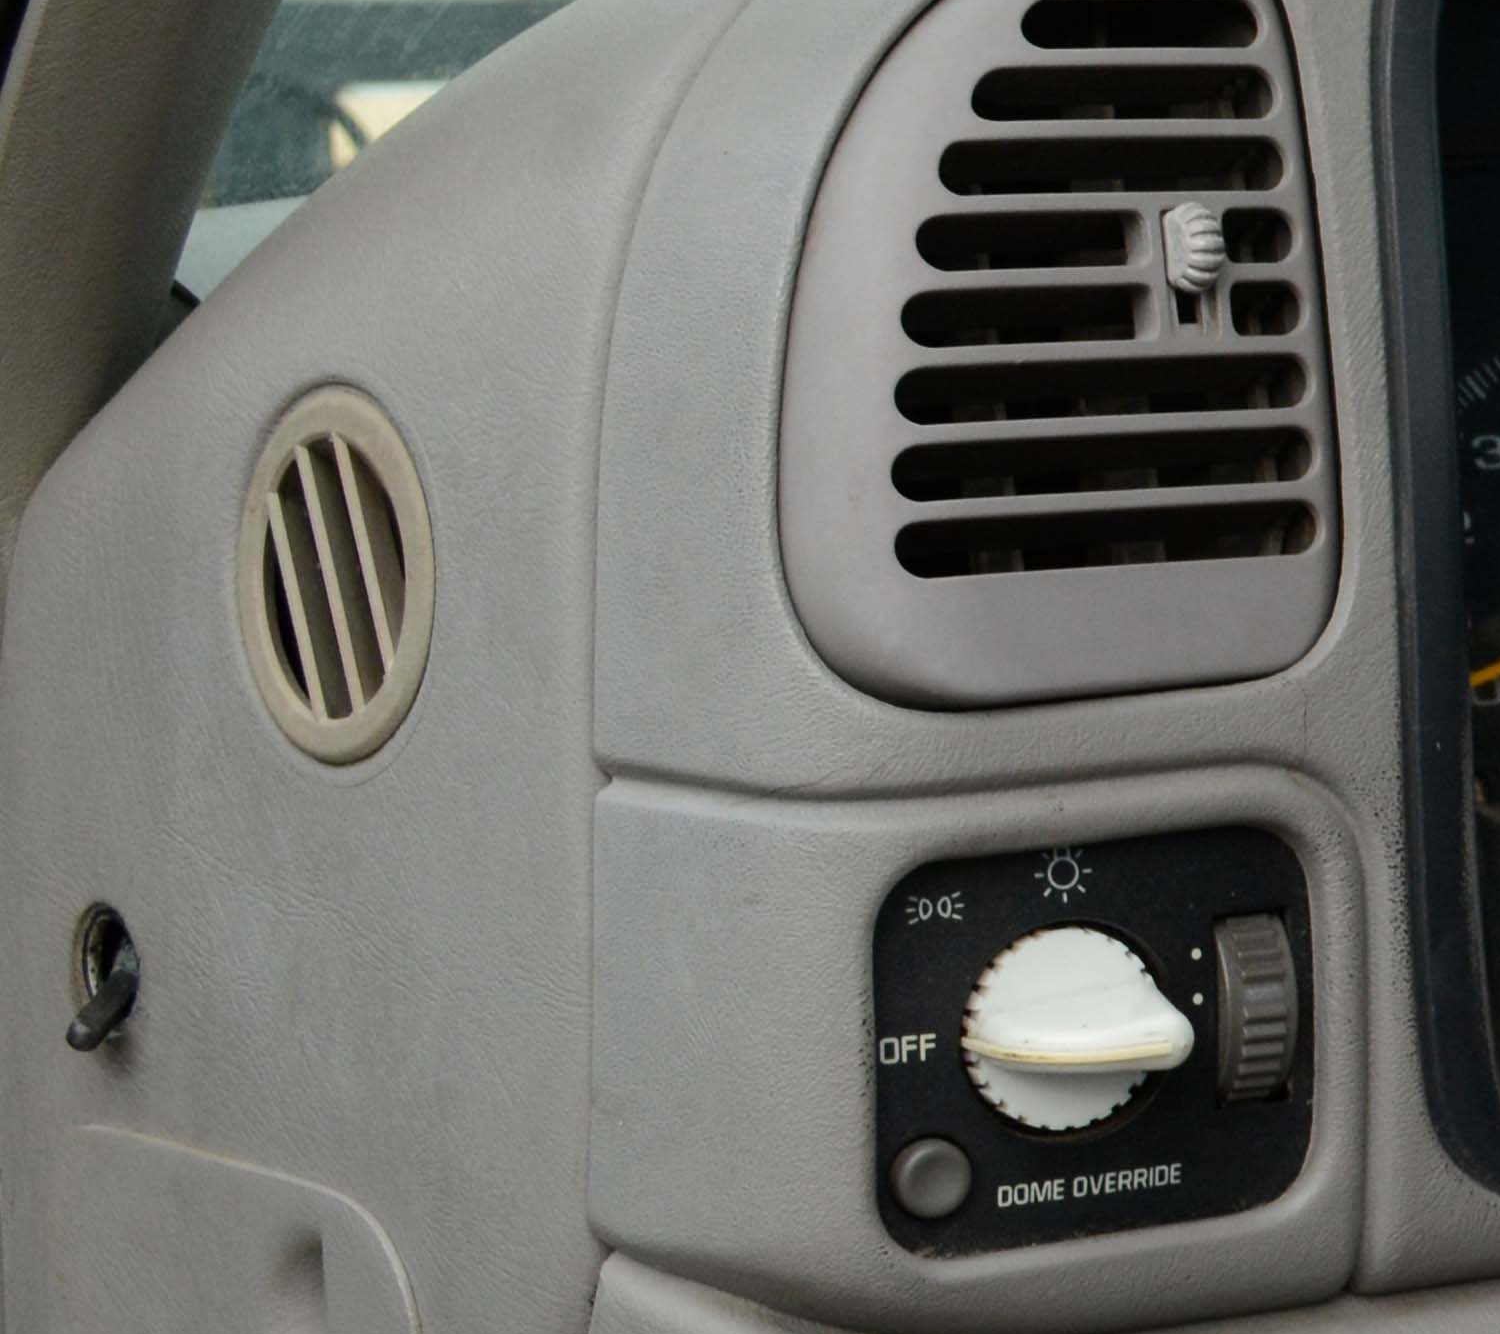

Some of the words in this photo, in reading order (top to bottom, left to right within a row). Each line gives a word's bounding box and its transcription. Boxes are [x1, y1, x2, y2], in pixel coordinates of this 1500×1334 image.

[879, 1033, 937, 1066] OFF
[997, 1178, 1065, 1208] DOME
[1072, 1162, 1183, 1200] OVERRIDE
